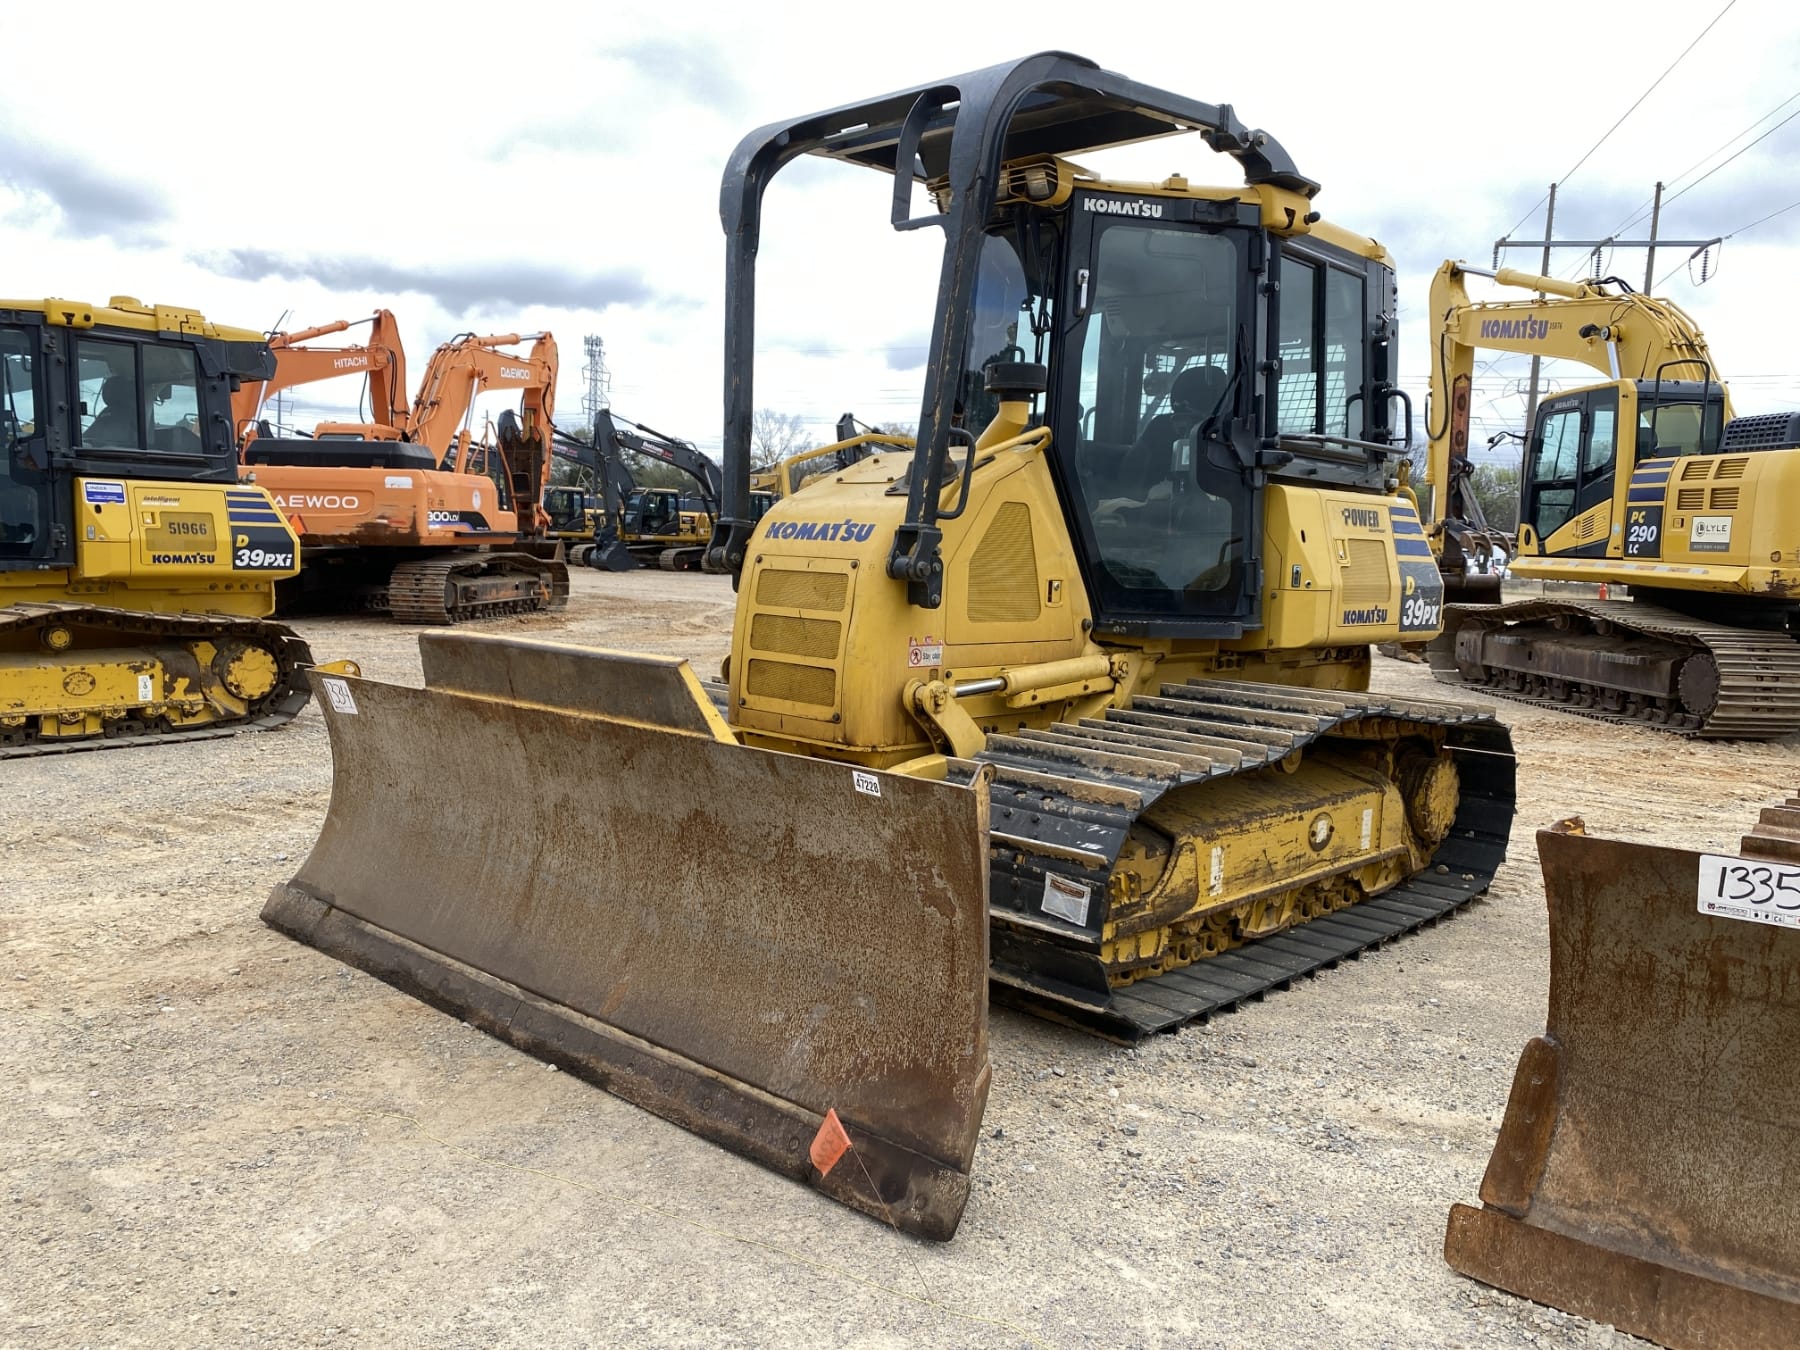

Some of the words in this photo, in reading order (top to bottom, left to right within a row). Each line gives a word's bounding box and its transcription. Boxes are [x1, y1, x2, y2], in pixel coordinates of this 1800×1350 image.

[1083, 197, 1163, 218] KOMATSU
[1480, 313, 1549, 340] KOMATSU
[333, 355, 368, 369] HITACHI
[500, 366, 530, 380] DAEWOO
[274, 494, 360, 509] AEWOO
[1341, 508, 1380, 528] POWER
[1630, 511, 1646, 524] PC
[168, 522, 208, 536] 51966
[764, 519, 877, 542] KOMATSU
[1628, 525, 1657, 542] 290
[1705, 524, 1728, 532] LYLE
[235, 533, 250, 548] D
[1628, 543, 1640, 554] LC
[152, 552, 216, 564] KOMATSU
[234, 548, 293, 567] 39PXi
[1405, 575, 1416, 596] D
[1343, 605, 1388, 625] KOMATSU
[1402, 599, 1440, 626] 39PX
[324, 680, 352, 707] 1334
[856, 778, 879, 794] 47228
[1717, 866, 1800, 910] 1335
